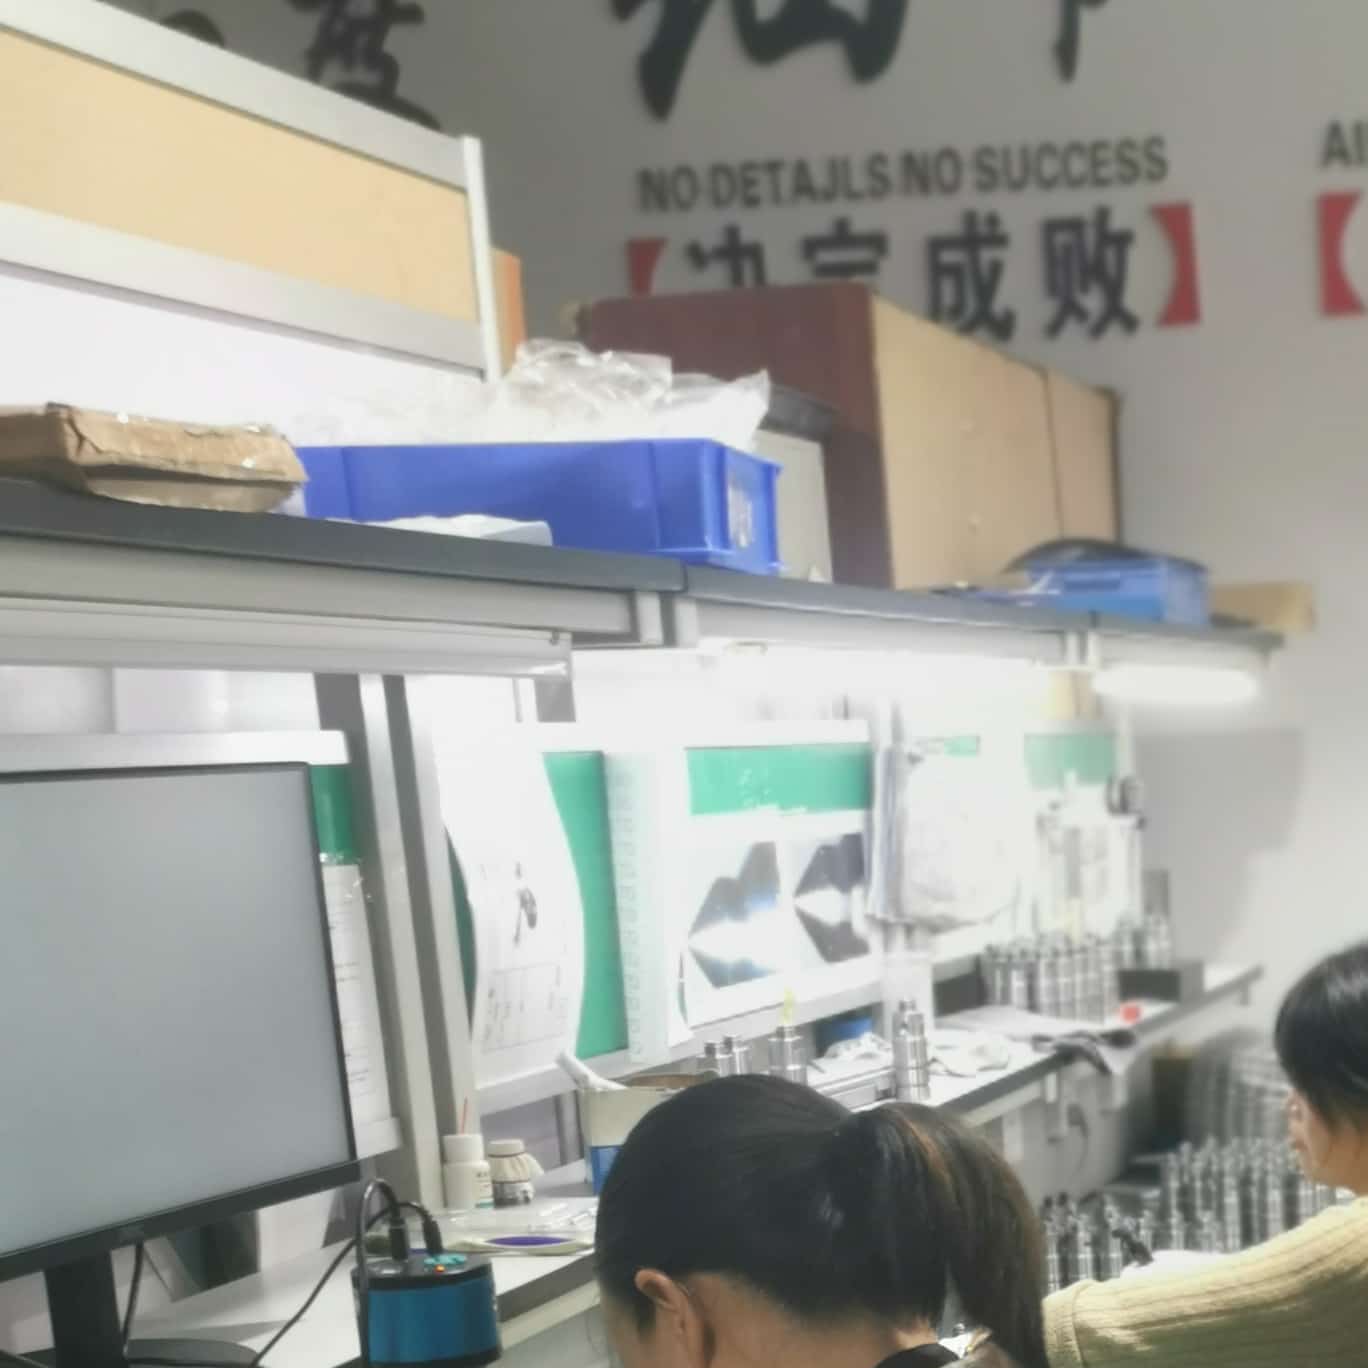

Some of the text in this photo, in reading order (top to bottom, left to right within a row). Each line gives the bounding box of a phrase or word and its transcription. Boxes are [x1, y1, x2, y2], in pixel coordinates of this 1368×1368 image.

[638, 162, 697, 212] NO
[902, 147, 961, 196] NO
[975, 134, 1168, 192] SUCCESS
